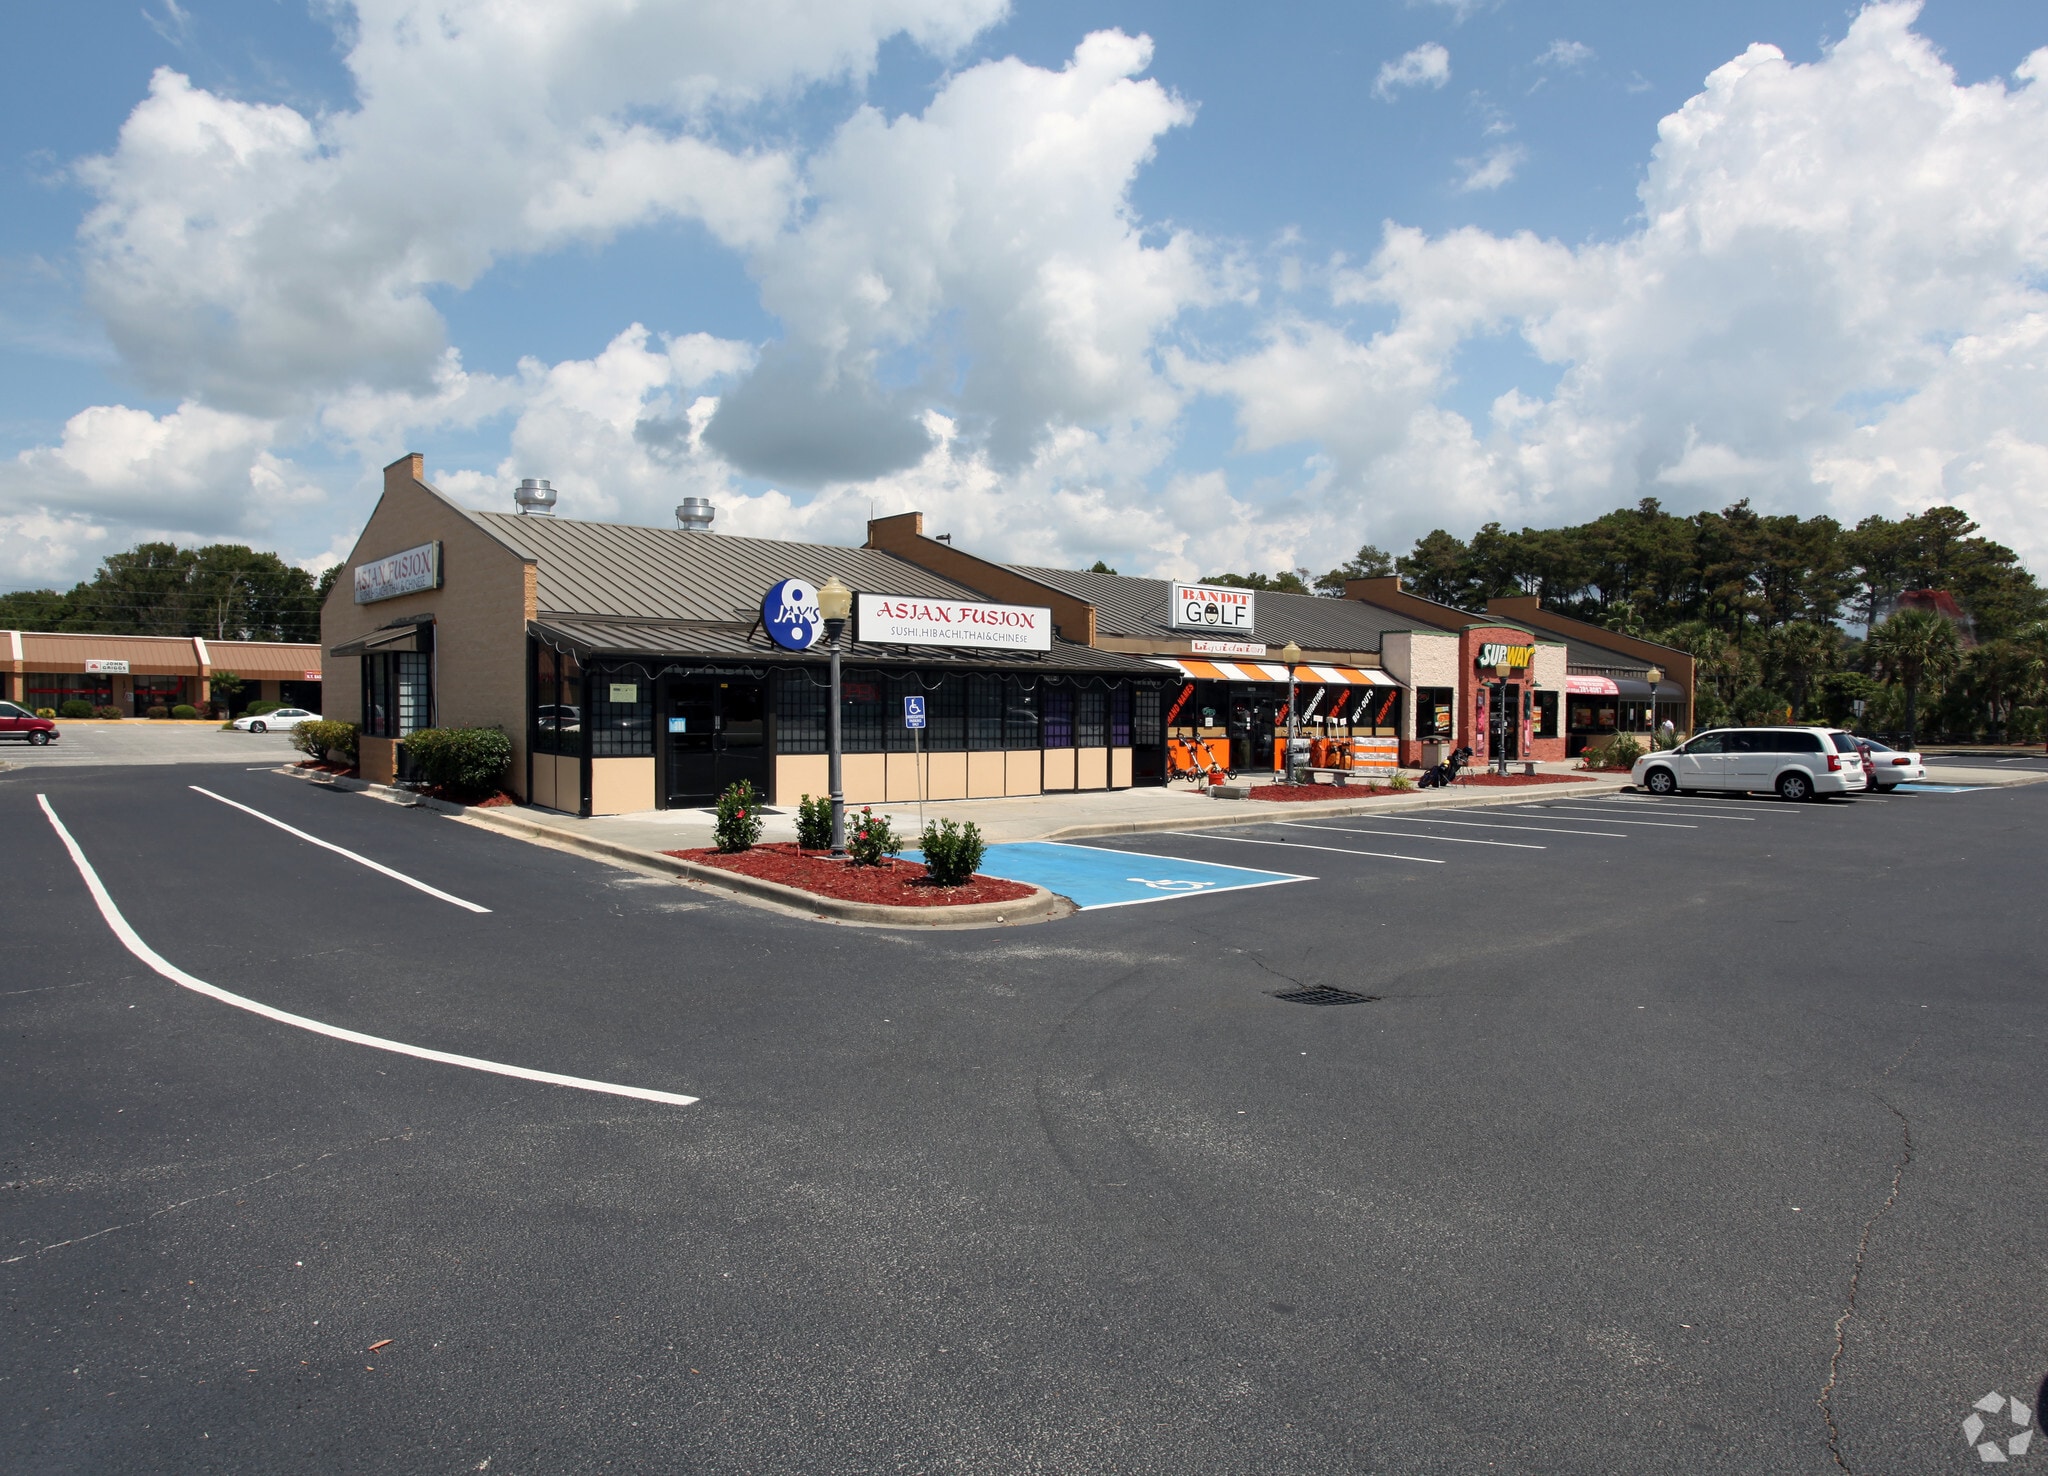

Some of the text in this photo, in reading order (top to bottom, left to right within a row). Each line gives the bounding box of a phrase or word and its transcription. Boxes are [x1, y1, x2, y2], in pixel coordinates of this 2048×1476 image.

[388, 549, 431, 582] FUSION
[1182, 589, 1250, 606] BANDIT
[773, 605, 820, 625] JAY'S
[876, 601, 1035, 629] ASIAN FUSION
[1185, 601, 1247, 626] GOLF
[1480, 644, 1535, 667] SUBWAY
[1301, 685, 1326, 725] LIQUIDATIONS
[1351, 688, 1374, 724] BUY-OUTS
[1375, 689, 1398, 725] SURPLUS
